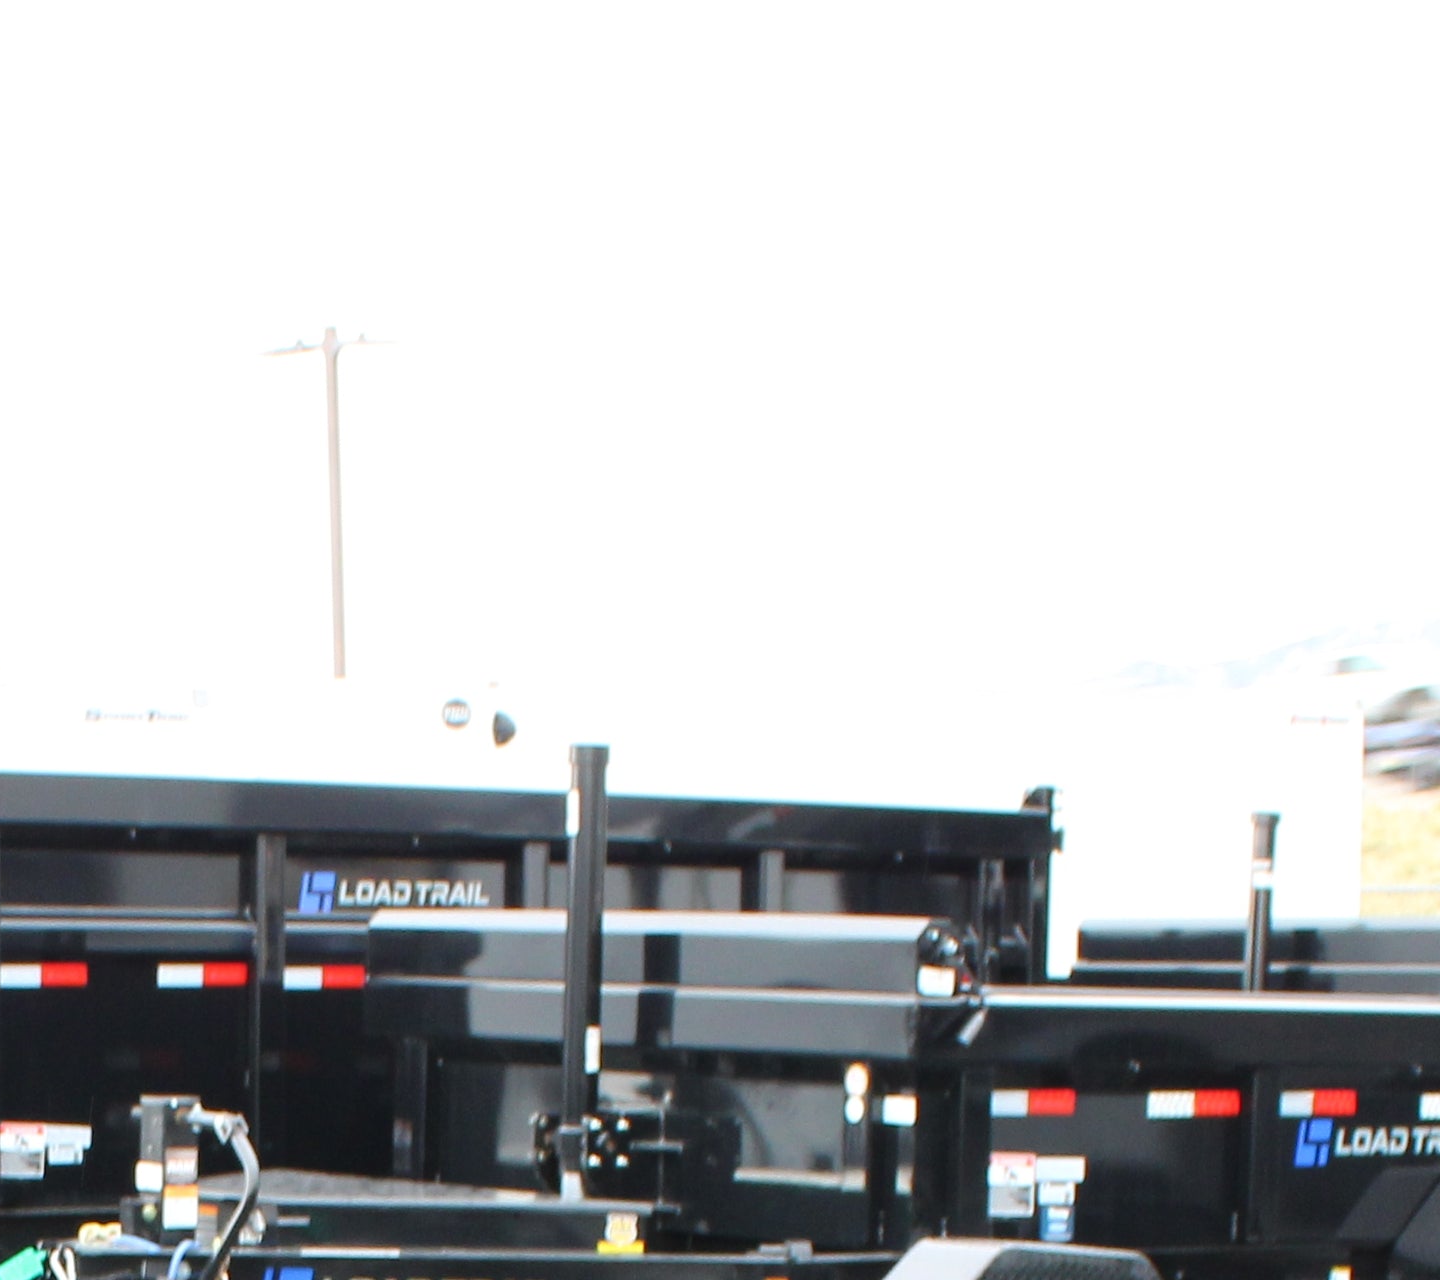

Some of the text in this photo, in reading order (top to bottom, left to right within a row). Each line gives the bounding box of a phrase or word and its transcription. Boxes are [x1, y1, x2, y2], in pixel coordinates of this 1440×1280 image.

[337, 878, 490, 907] LOAD TRAIL
[1334, 1125, 1410, 1158] LOAD
